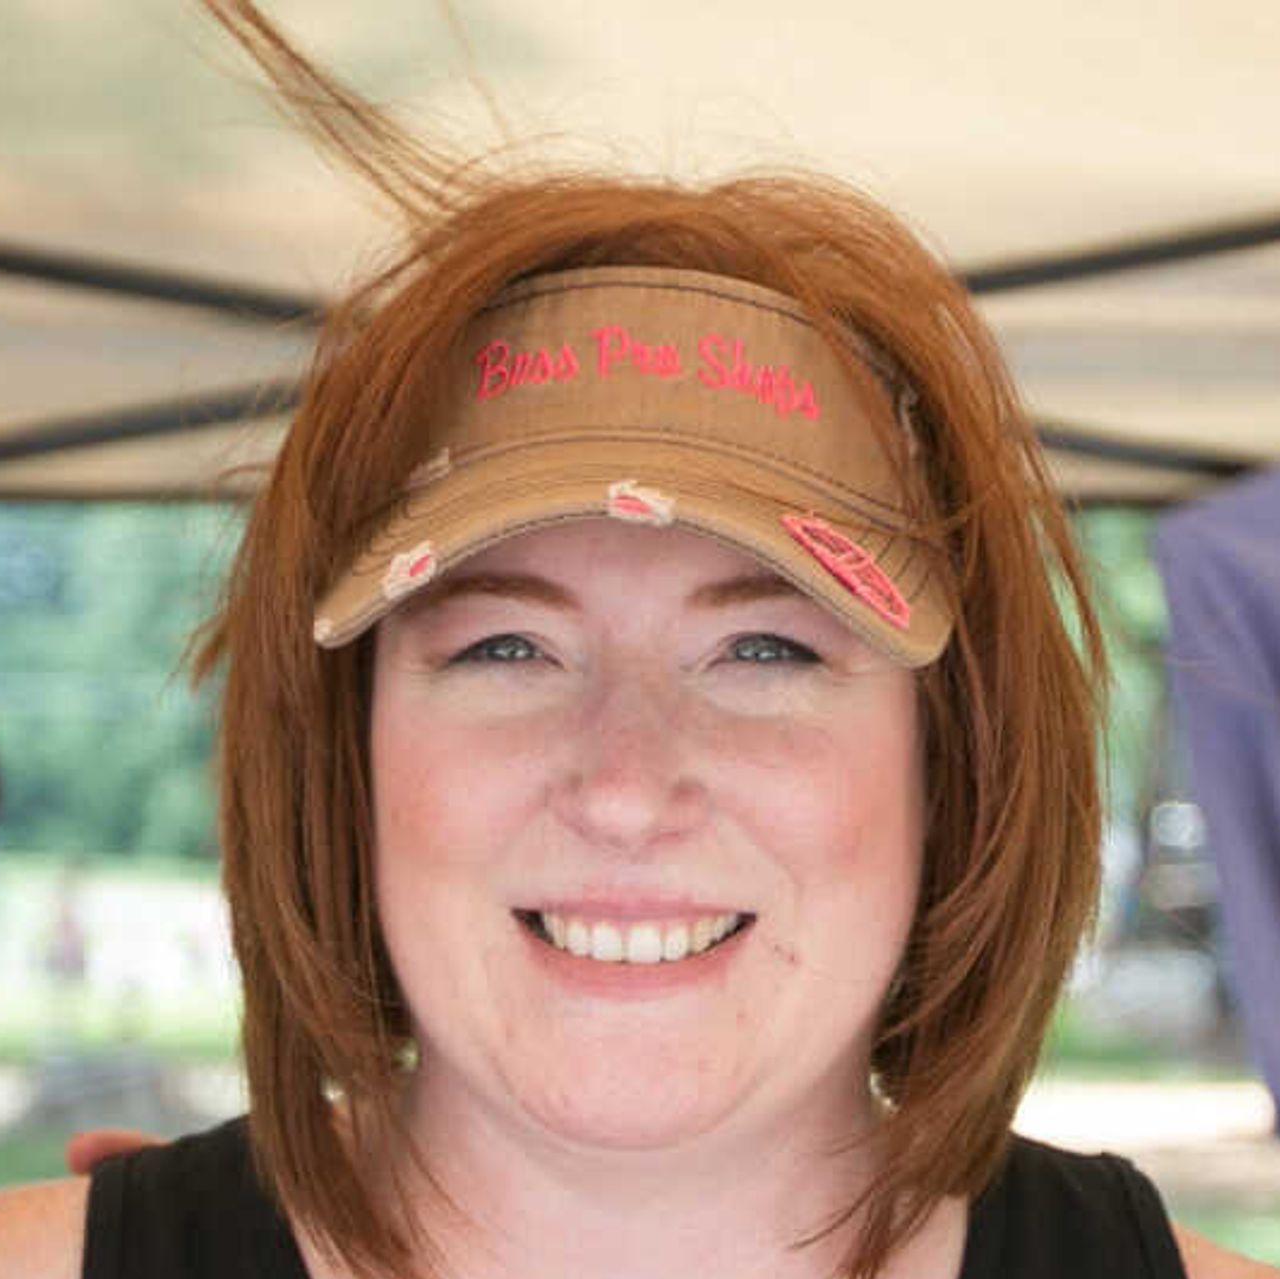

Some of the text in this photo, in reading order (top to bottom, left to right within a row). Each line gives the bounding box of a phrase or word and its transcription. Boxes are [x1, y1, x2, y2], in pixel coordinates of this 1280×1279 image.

[475, 324, 821, 421] Bass Pro Shops
